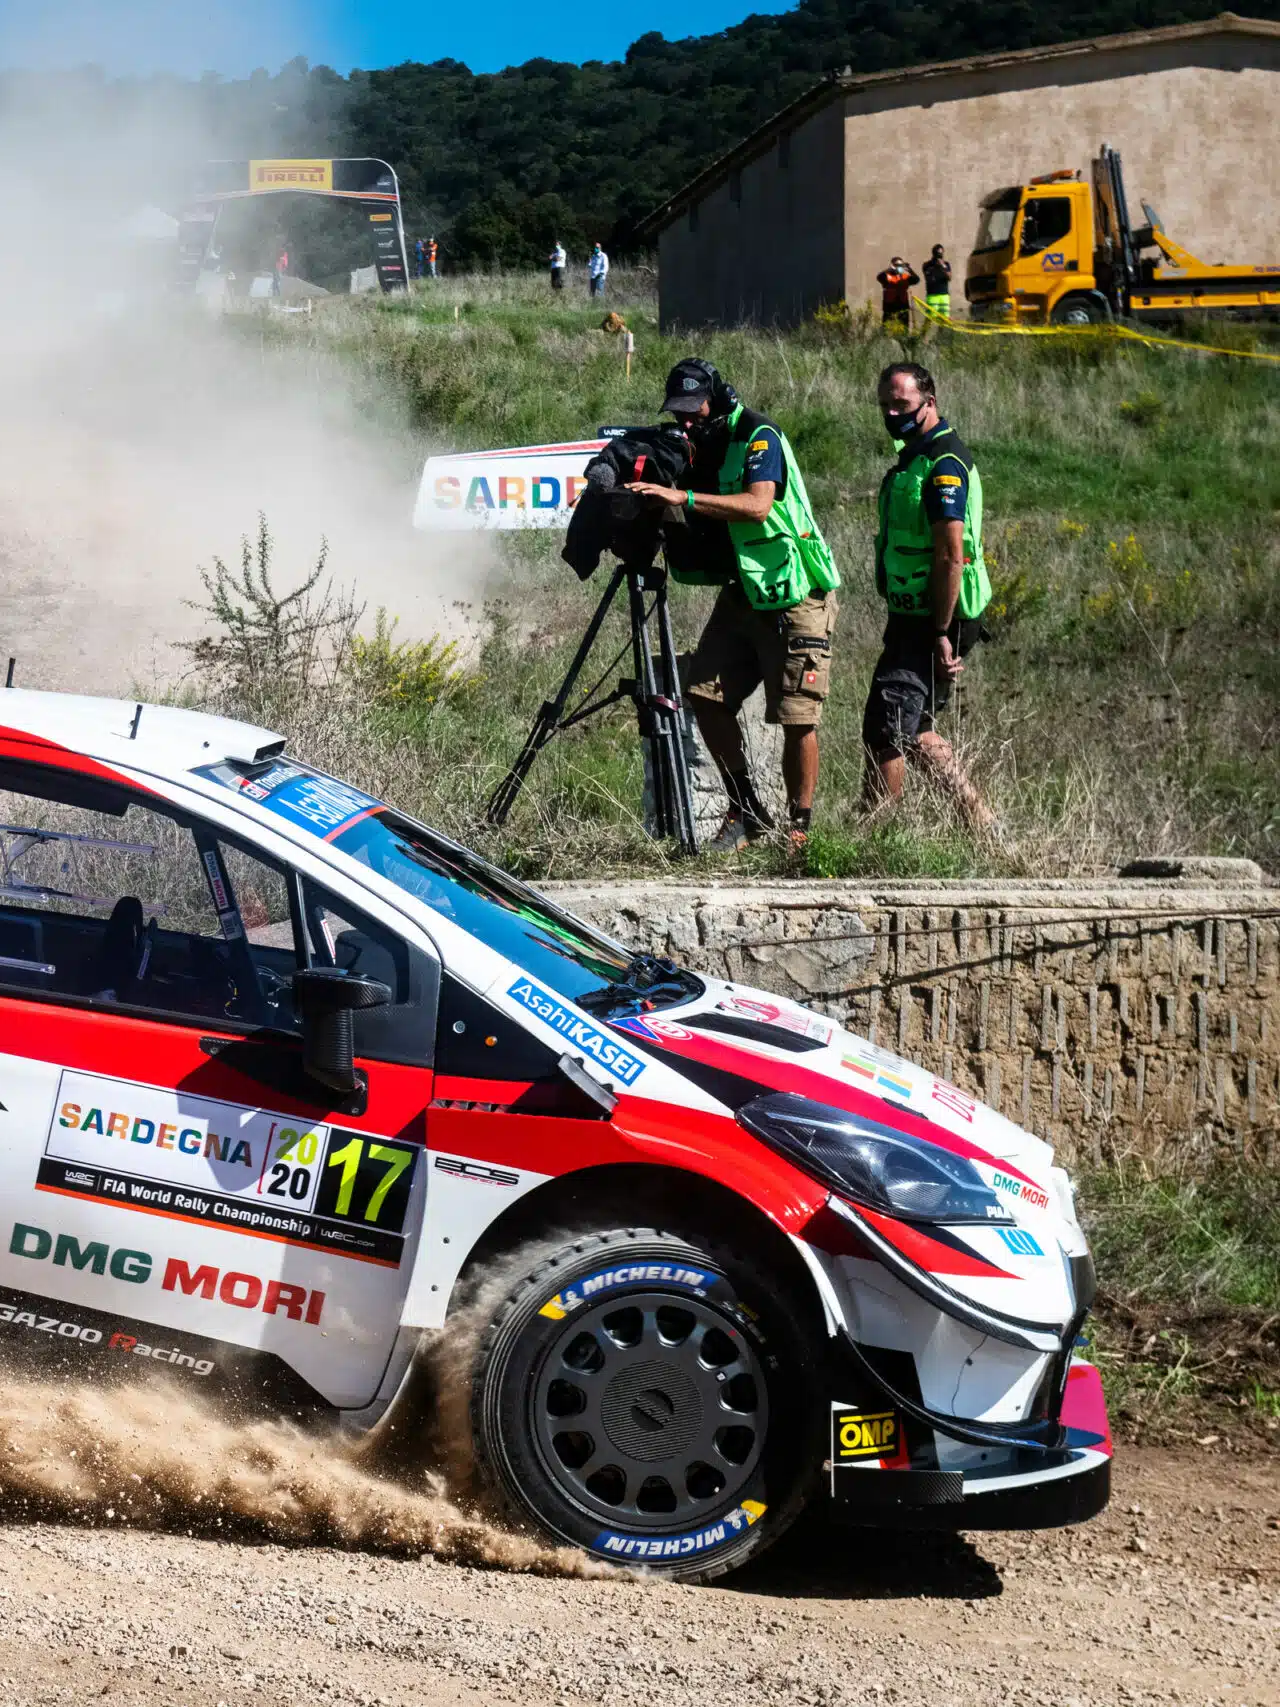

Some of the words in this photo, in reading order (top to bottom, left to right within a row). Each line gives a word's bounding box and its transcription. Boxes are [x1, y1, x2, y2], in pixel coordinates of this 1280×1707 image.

[257, 167, 325, 183] PIRELLI
[511, 983, 641, 1081] AsahiKASEI
[59, 1102, 252, 1168] SARDEGNA
[273, 1128, 319, 1166] 20
[267, 1163, 311, 1200] 20
[328, 1138, 413, 1222] 17
[993, 1172, 1021, 1196] DMG
[1020, 1186, 1049, 1209] MORI
[103, 1178, 127, 1195] FIA
[130, 1184, 172, 1204] World
[174, 1194, 210, 1215] Rally
[213, 1202, 311, 1237] Championship
[9, 1222, 153, 1284] DMG
[161, 1257, 326, 1325] MORI
[581, 1266, 705, 1296] MICHELIN
[107, 1332, 216, 1376] Racing
[840, 1419, 895, 1448] OMP
[604, 1524, 725, 1556] MICHELIN
